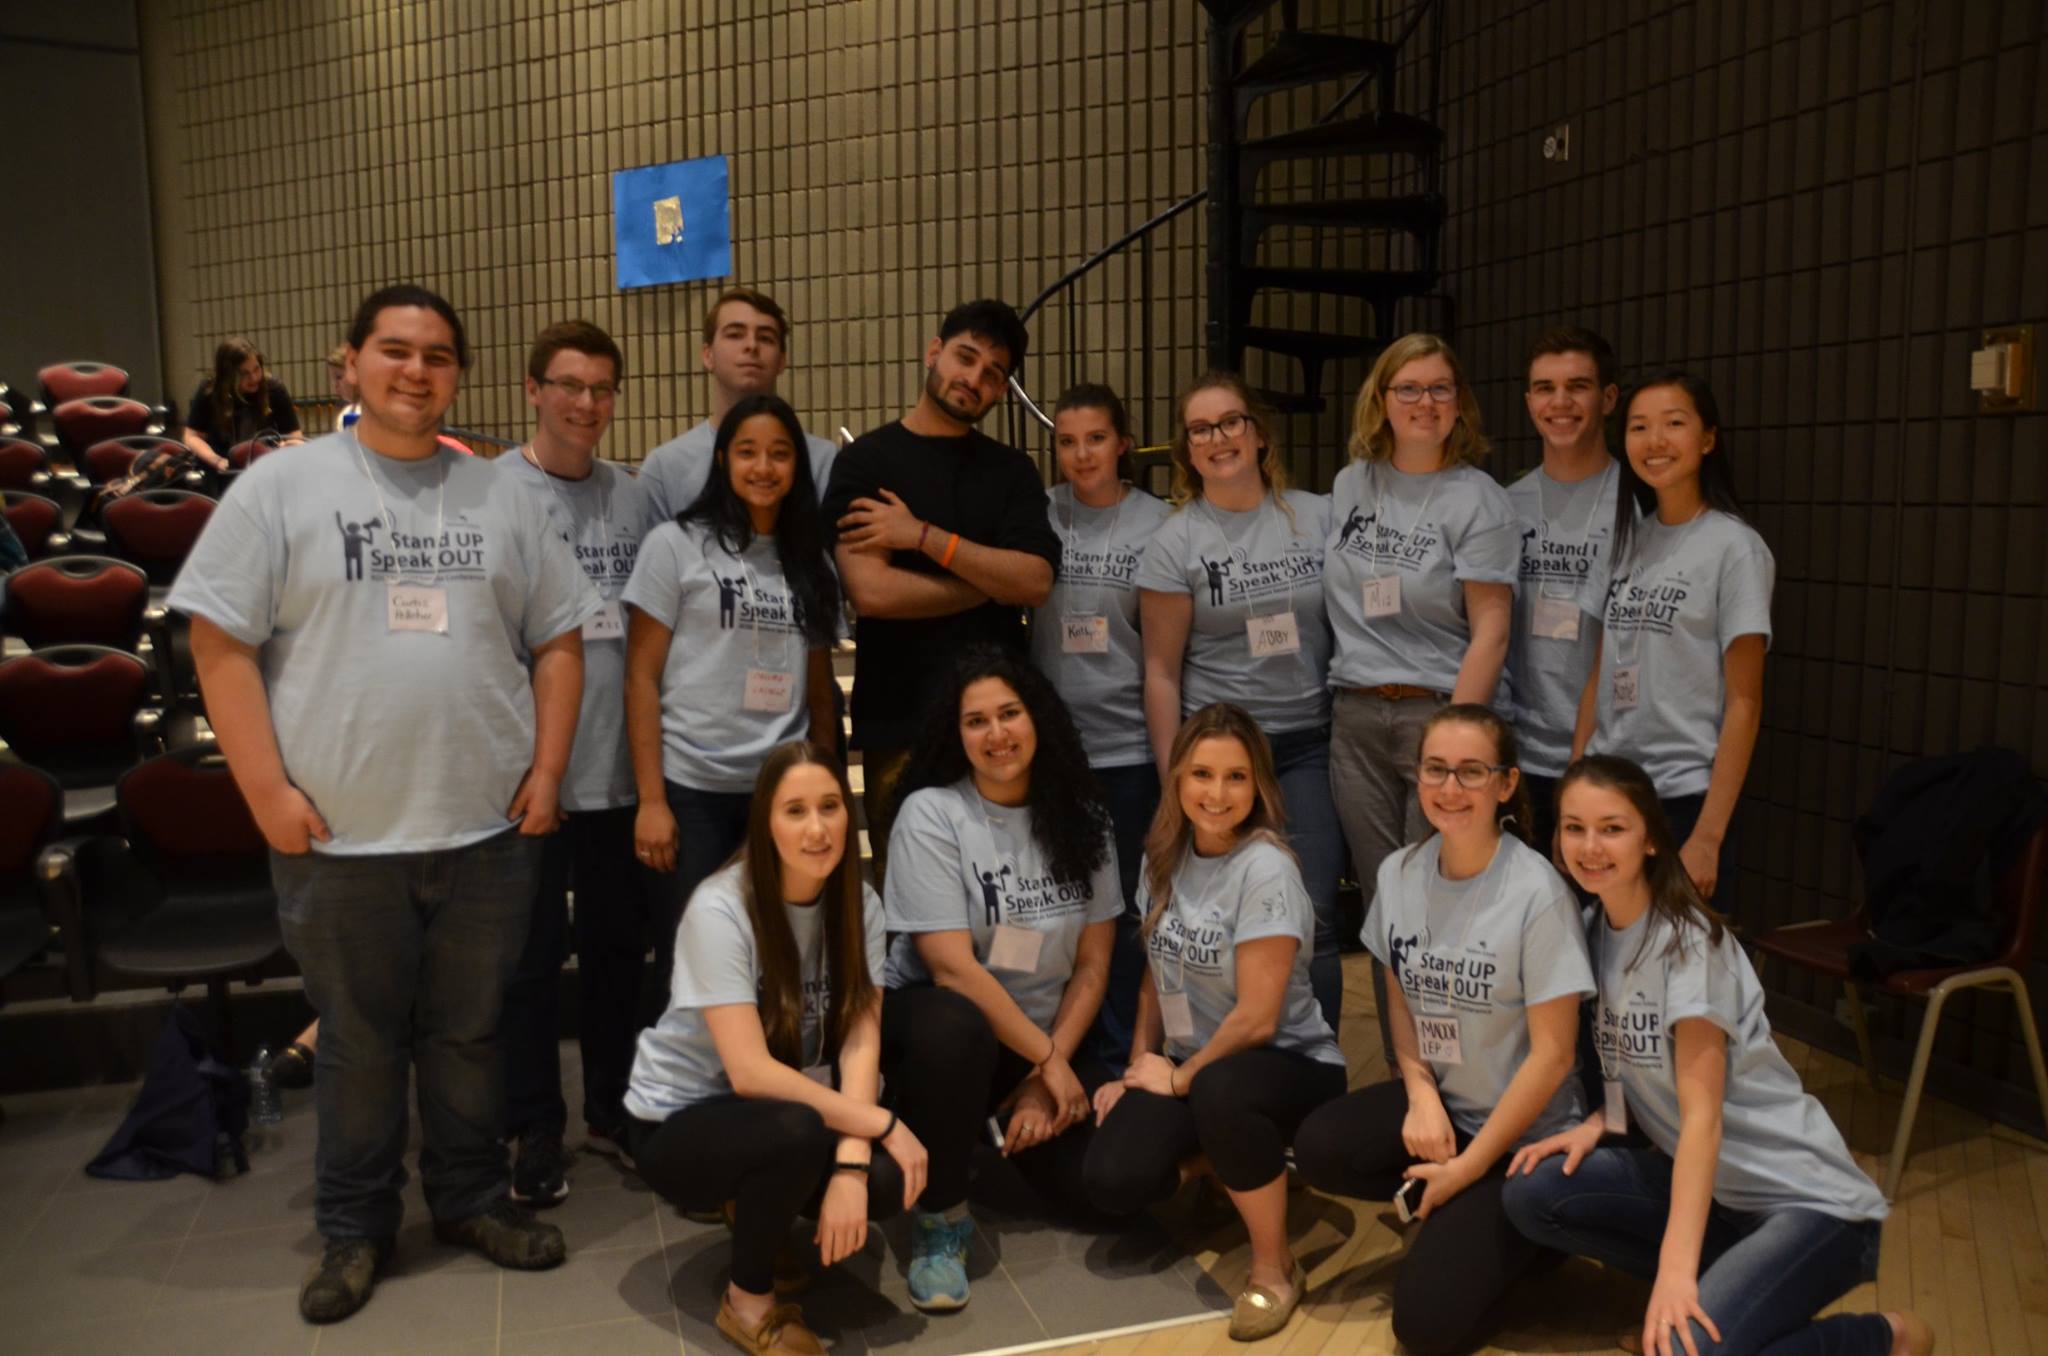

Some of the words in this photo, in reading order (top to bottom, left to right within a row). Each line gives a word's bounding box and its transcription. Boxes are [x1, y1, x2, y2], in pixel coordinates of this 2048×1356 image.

[391, 531, 449, 549] Stand
[456, 532, 484, 547] UP
[1413, 533, 1437, 548] UP
[1541, 539, 1588, 557] Stand
[371, 549, 433, 571] Speak
[438, 549, 485, 566] OUT
[1115, 553, 1137, 566] UP
[1521, 555, 1572, 574] Speak
[1228, 571, 1281, 593] Speak
[1660, 584, 1688, 605] UP
[740, 601, 788, 621] Speak
[1004, 889, 1056, 914] Speak
[1187, 945, 1221, 965] OUT
[1420, 951, 1466, 976] Stand
[1468, 960, 1496, 981] UP
[1404, 968, 1450, 992] Speak
[1453, 977, 1493, 1001] OUT
[1631, 1012, 1660, 1033] UP
[1621, 1034, 1662, 1054] OUT
